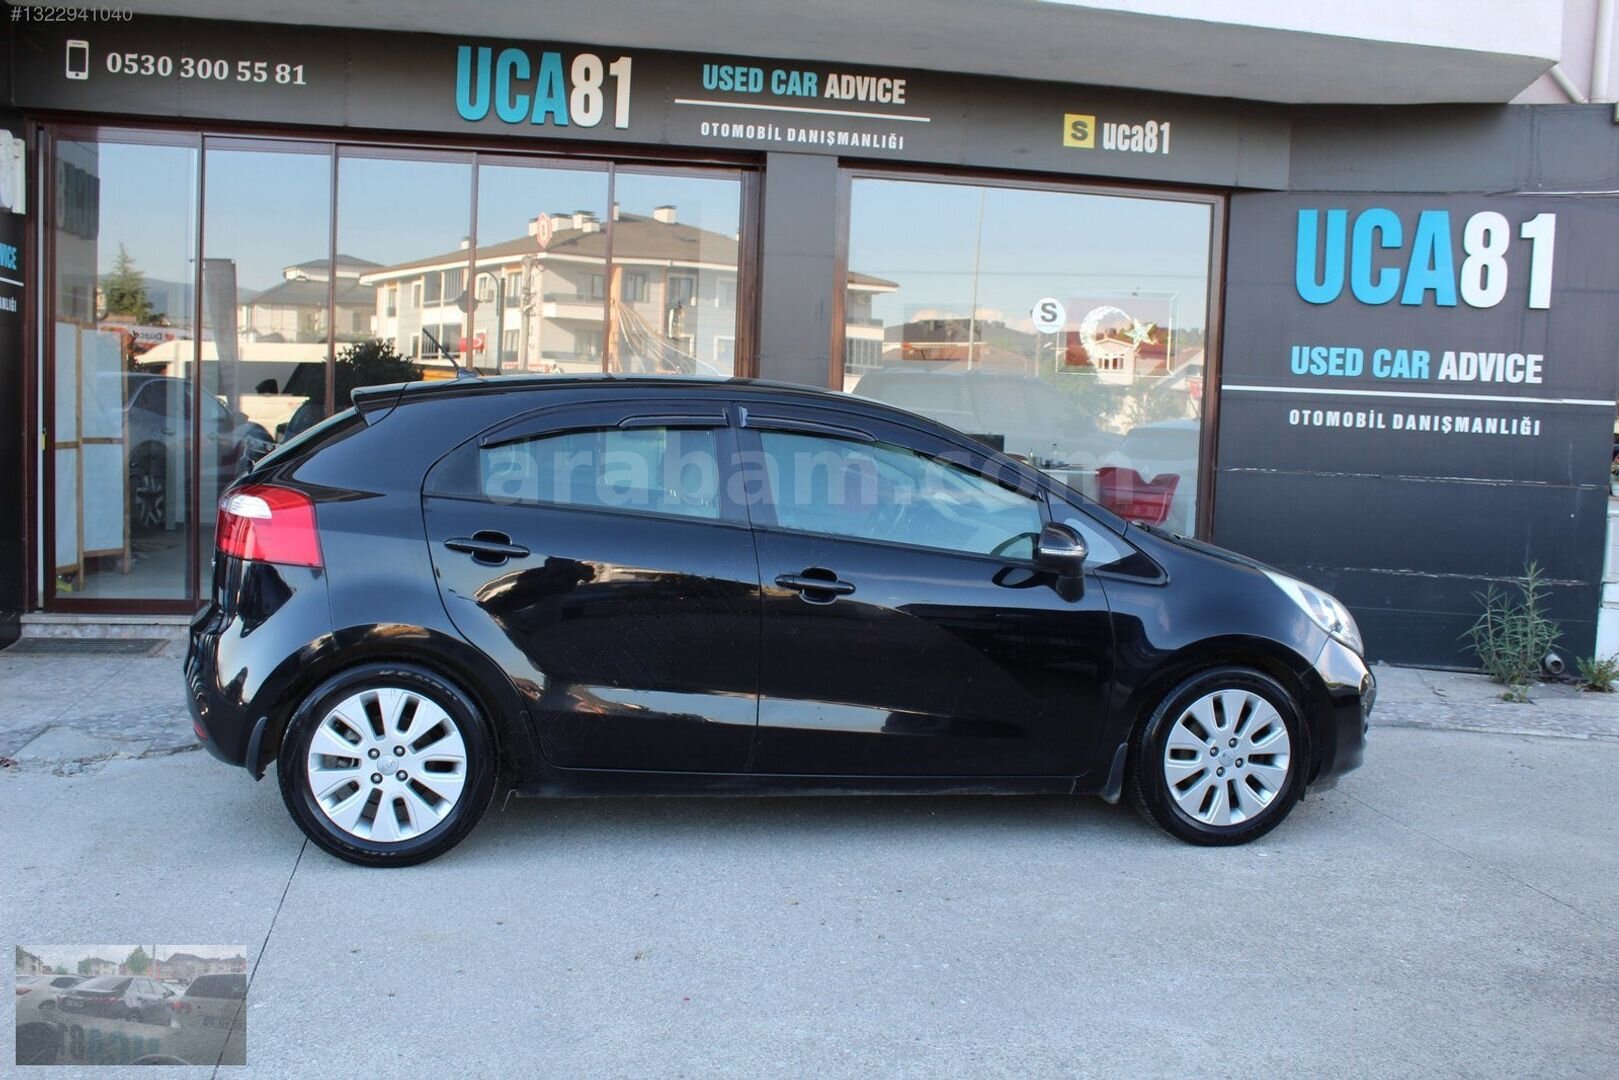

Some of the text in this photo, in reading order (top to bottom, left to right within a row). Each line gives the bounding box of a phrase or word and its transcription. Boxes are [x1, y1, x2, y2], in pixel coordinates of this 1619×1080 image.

[106, 53, 306, 85] 0530 300 55 81
[455, 45, 632, 129] UCA81
[702, 64, 906, 104] USED CAR ADVICE
[701, 121, 904, 150] OTOMOBİL DANIŞMANLIĞI
[1103, 120, 1170, 154] uca81
[1296, 207, 1556, 309] UCA81
[1291, 346, 1544, 384] USED CAR ADVICE
[1289, 409, 1541, 436] OTOMOBİL DANIŞMANLIĞI
